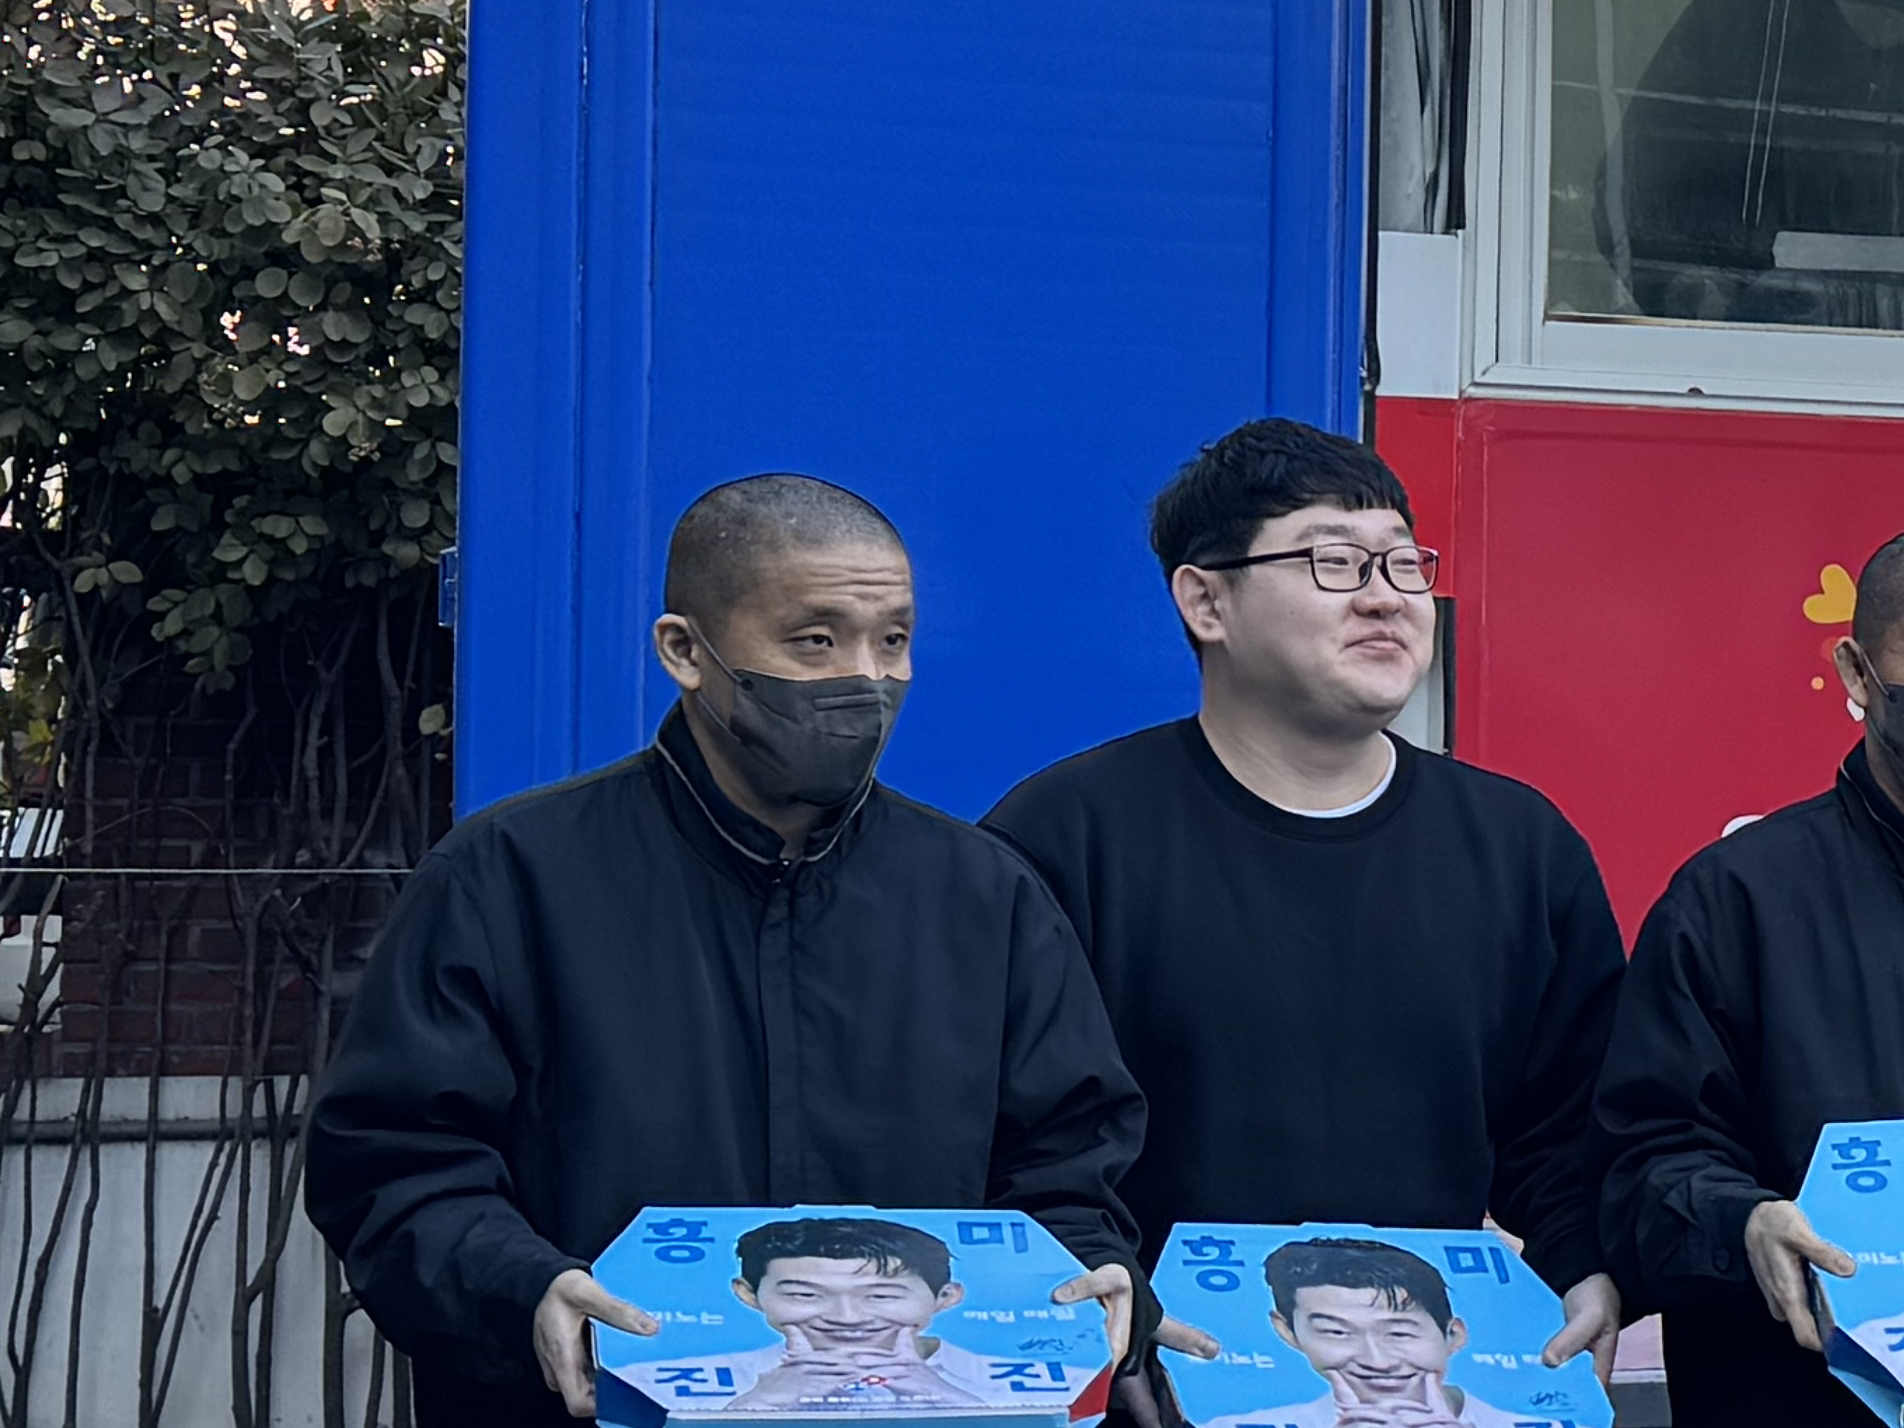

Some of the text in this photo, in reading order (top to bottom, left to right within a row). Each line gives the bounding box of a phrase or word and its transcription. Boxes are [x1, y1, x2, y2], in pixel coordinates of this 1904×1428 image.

[956, 1220, 1029, 1254] 미
[1443, 1245, 1511, 1285] 미
[656, 1360, 1071, 1398] 진 진
